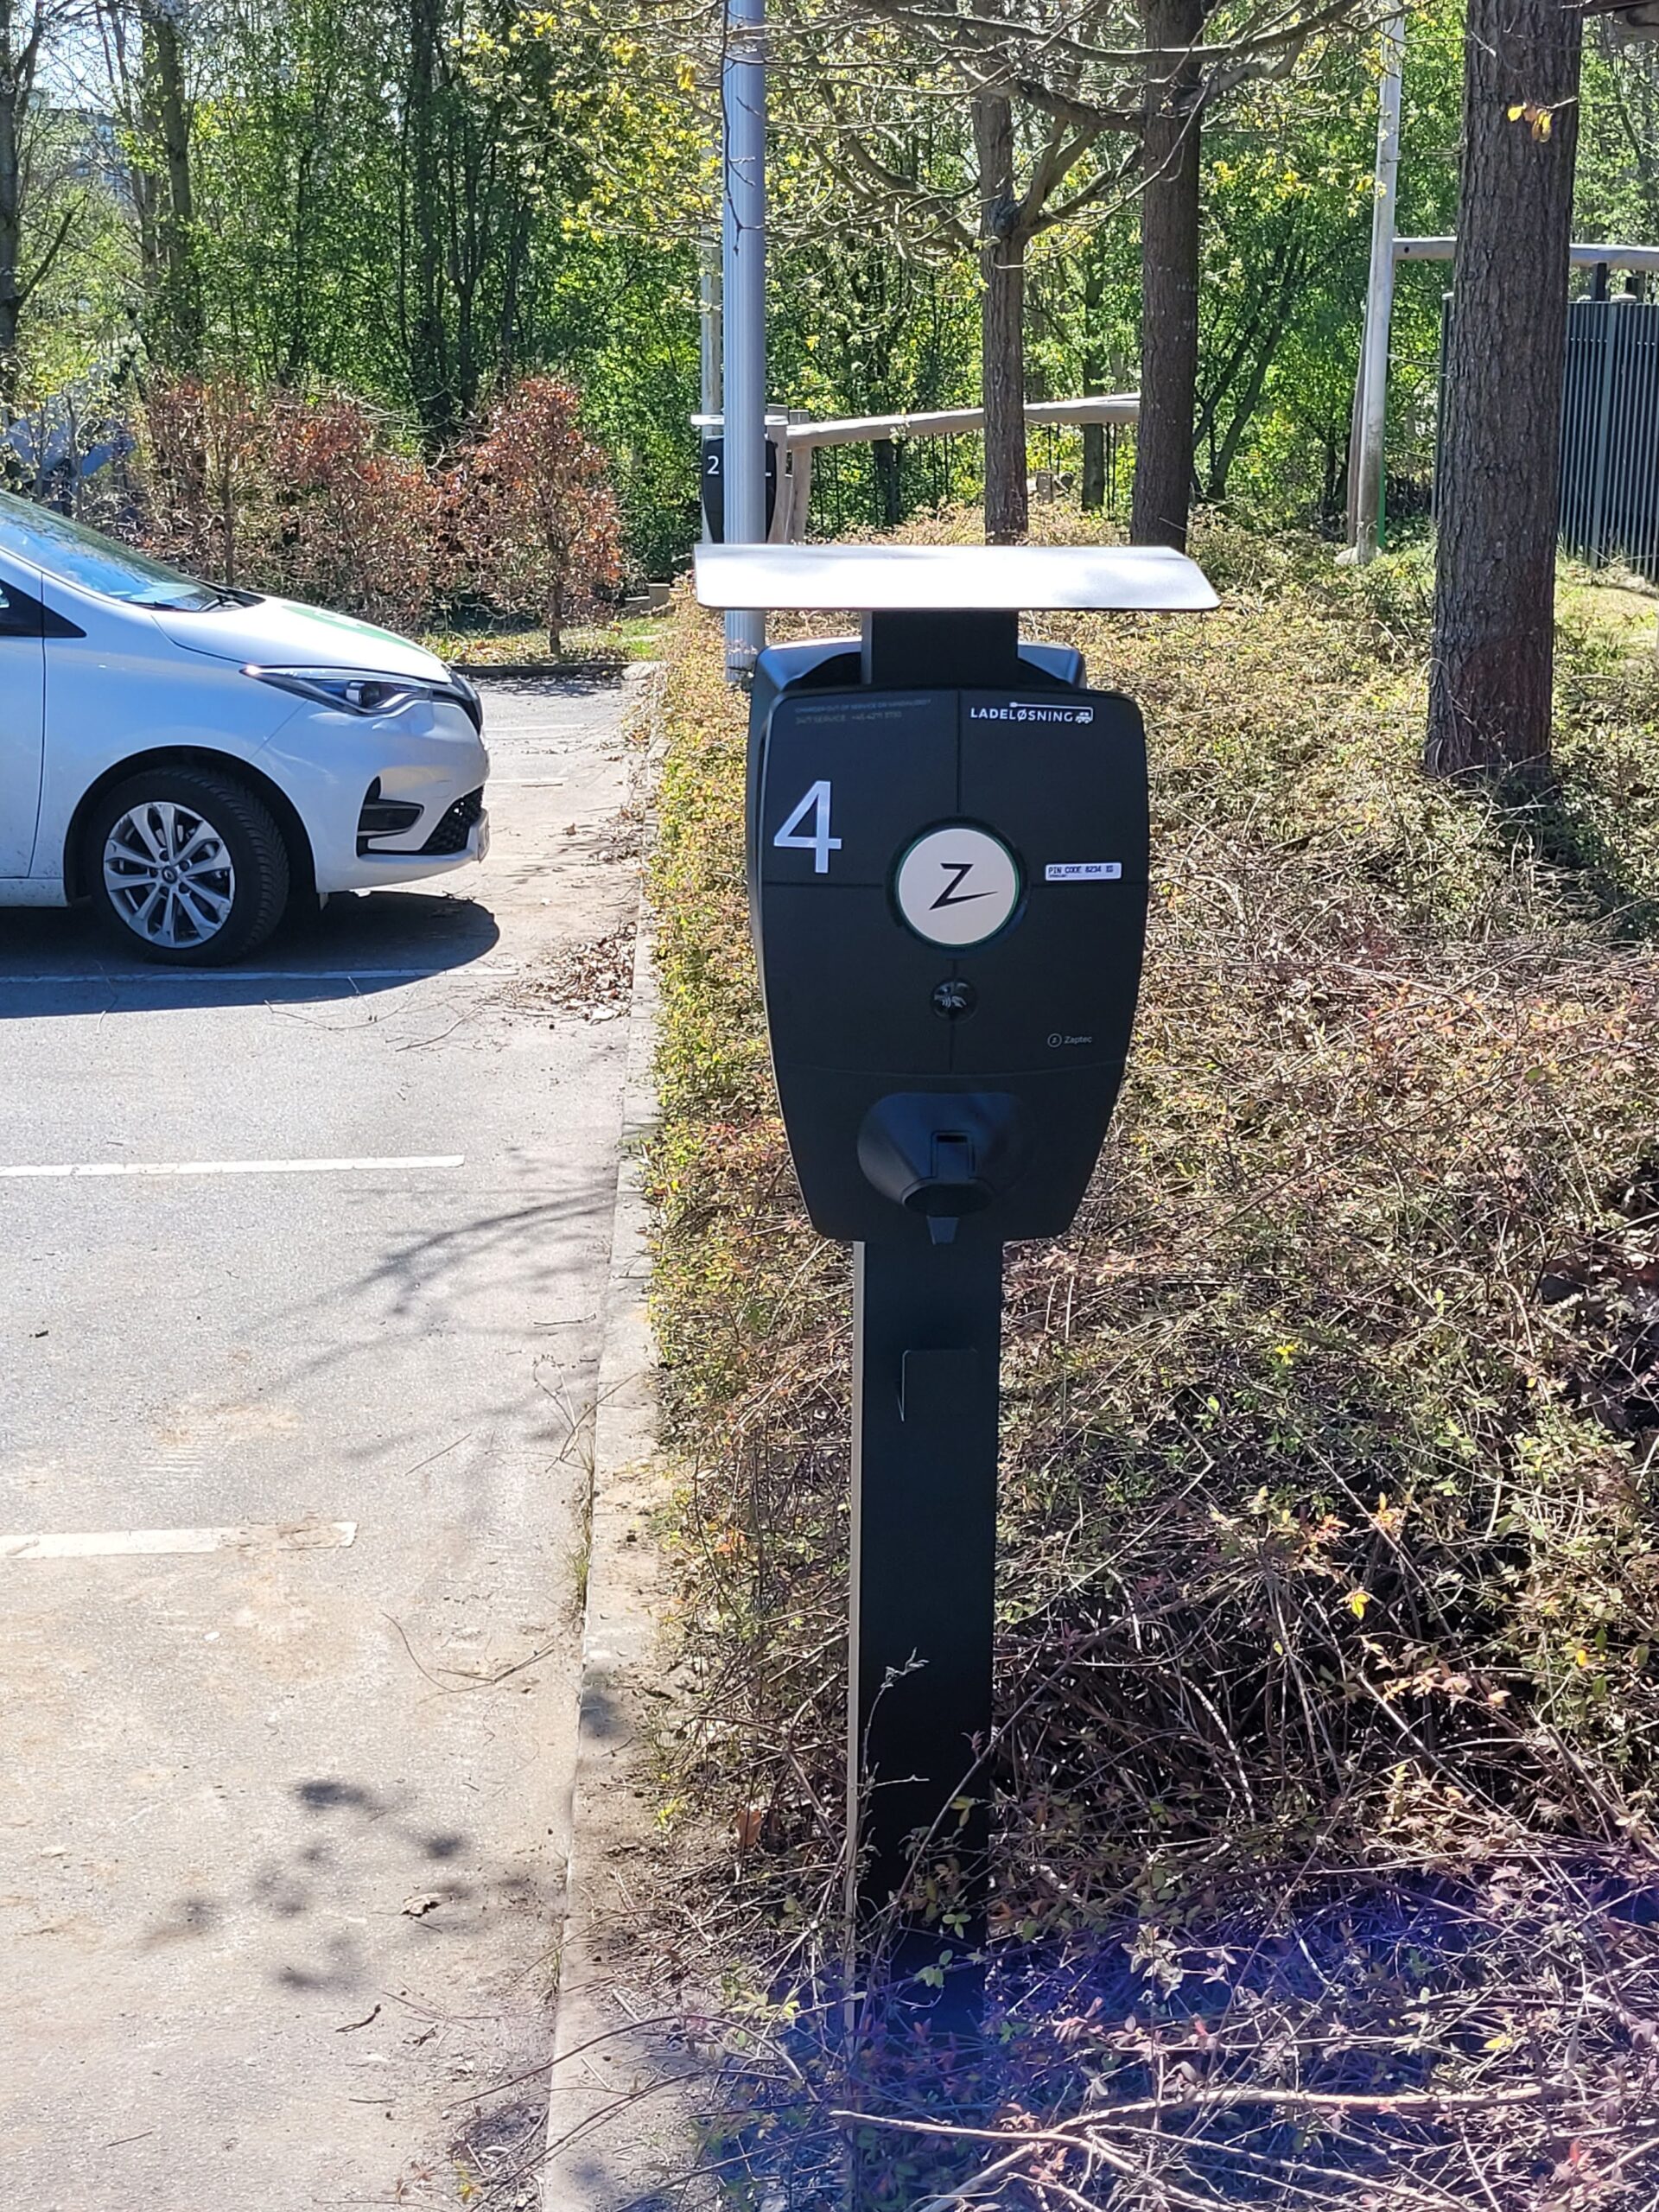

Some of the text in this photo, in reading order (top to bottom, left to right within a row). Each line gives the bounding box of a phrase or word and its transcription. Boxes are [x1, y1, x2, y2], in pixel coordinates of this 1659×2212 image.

[707, 455, 720, 475] 2
[850, 702, 876, 710] SERVICE
[969, 707, 1073, 723] LADELØSNING
[773, 780, 842, 874] 4
[1048, 866, 1062, 874] PIN
[1065, 865, 1082, 874] CODE
[1064, 1035, 1093, 1045] Zaptec
